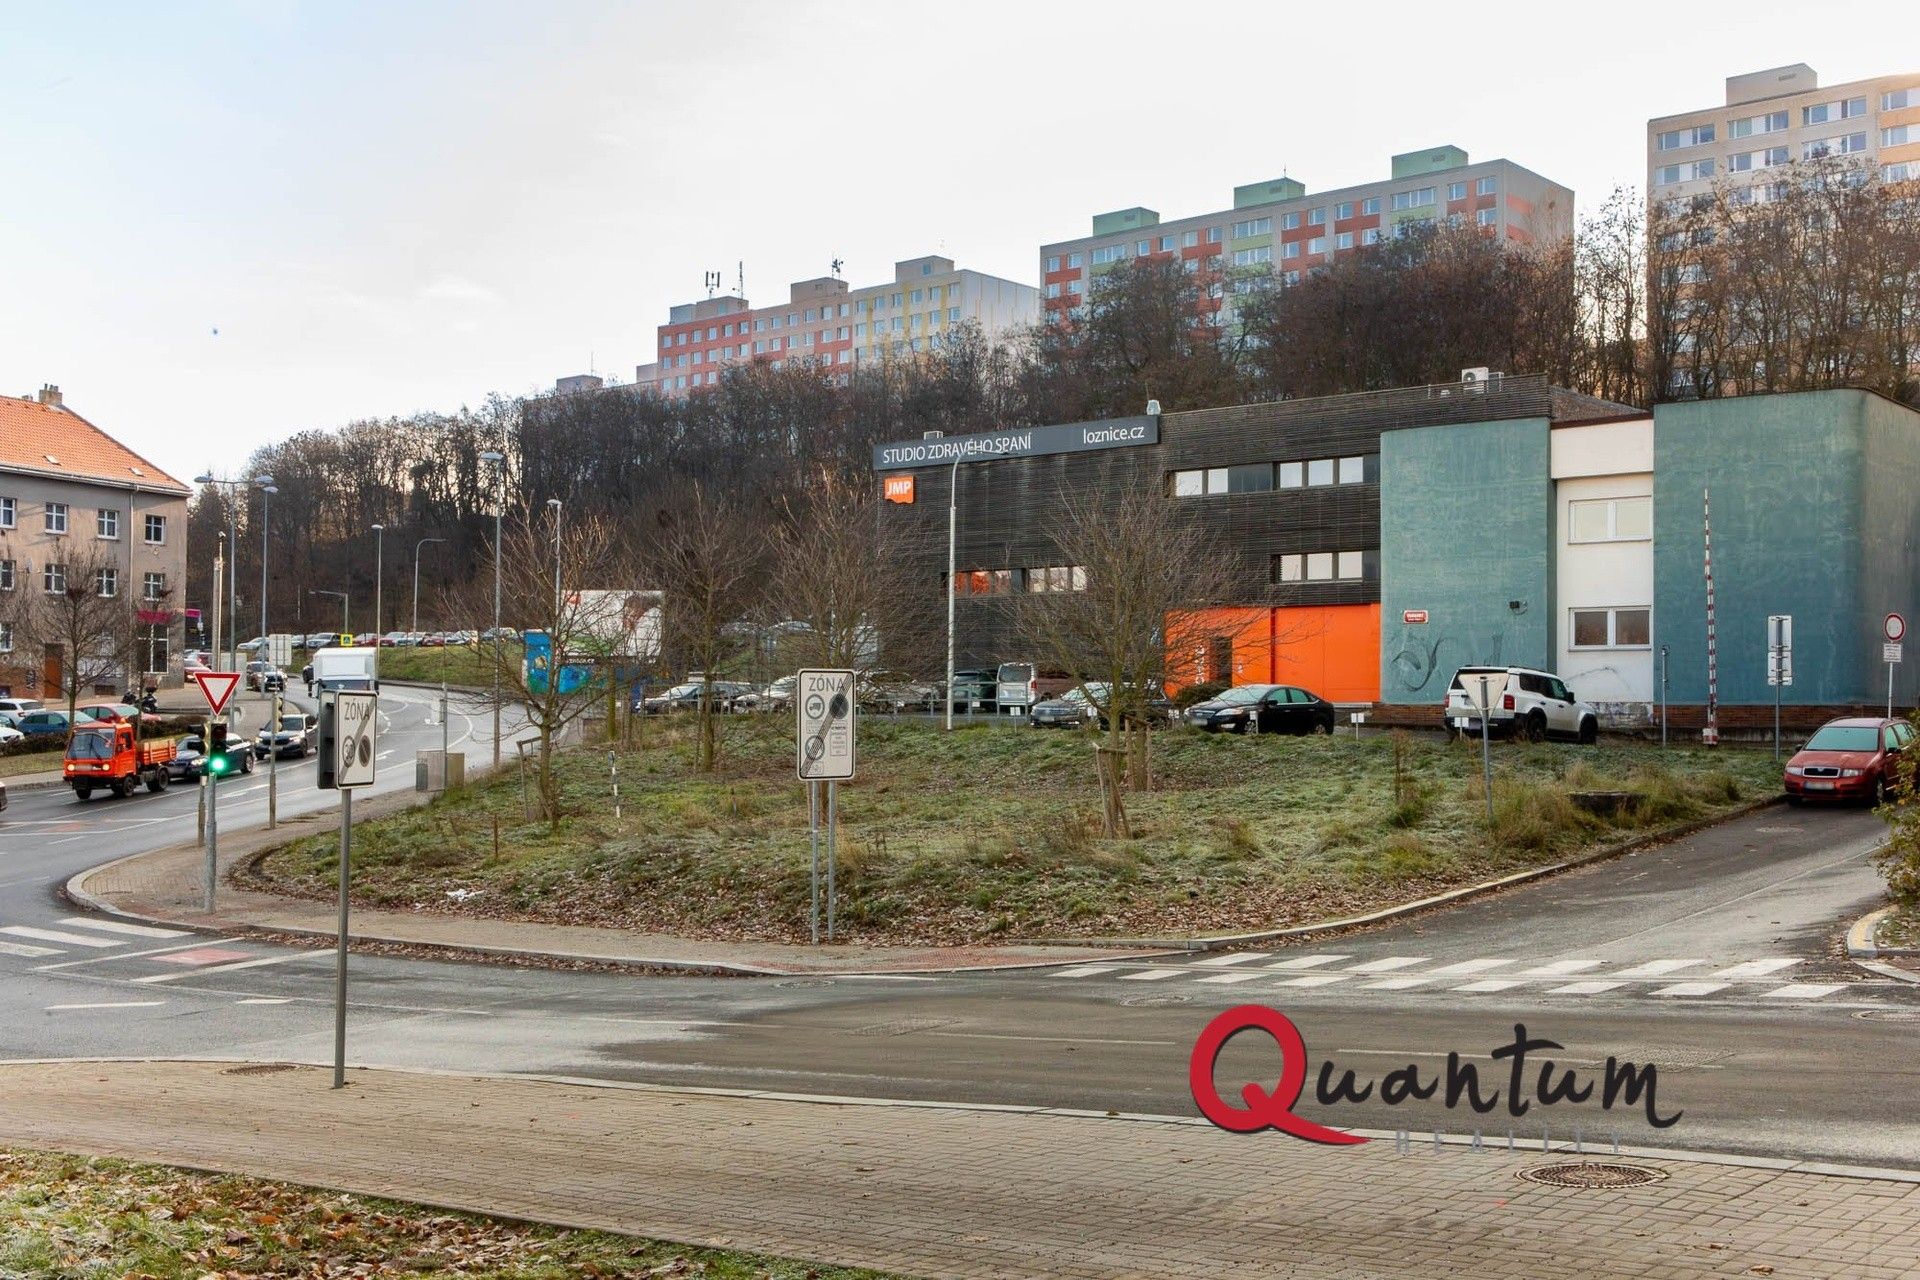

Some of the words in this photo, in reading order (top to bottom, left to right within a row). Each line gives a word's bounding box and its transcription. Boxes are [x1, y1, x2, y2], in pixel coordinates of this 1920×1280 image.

[1083, 426, 1145, 444] loznice.cz
[883, 446, 926, 464] STUDIO
[928, 438, 993, 460] ZDRAVÉHO
[995, 432, 1032, 452] SPANÍ
[887, 481, 912, 496] JMP
[809, 674, 846, 692] ZÓNA
[344, 698, 370, 721] ZÓNA
